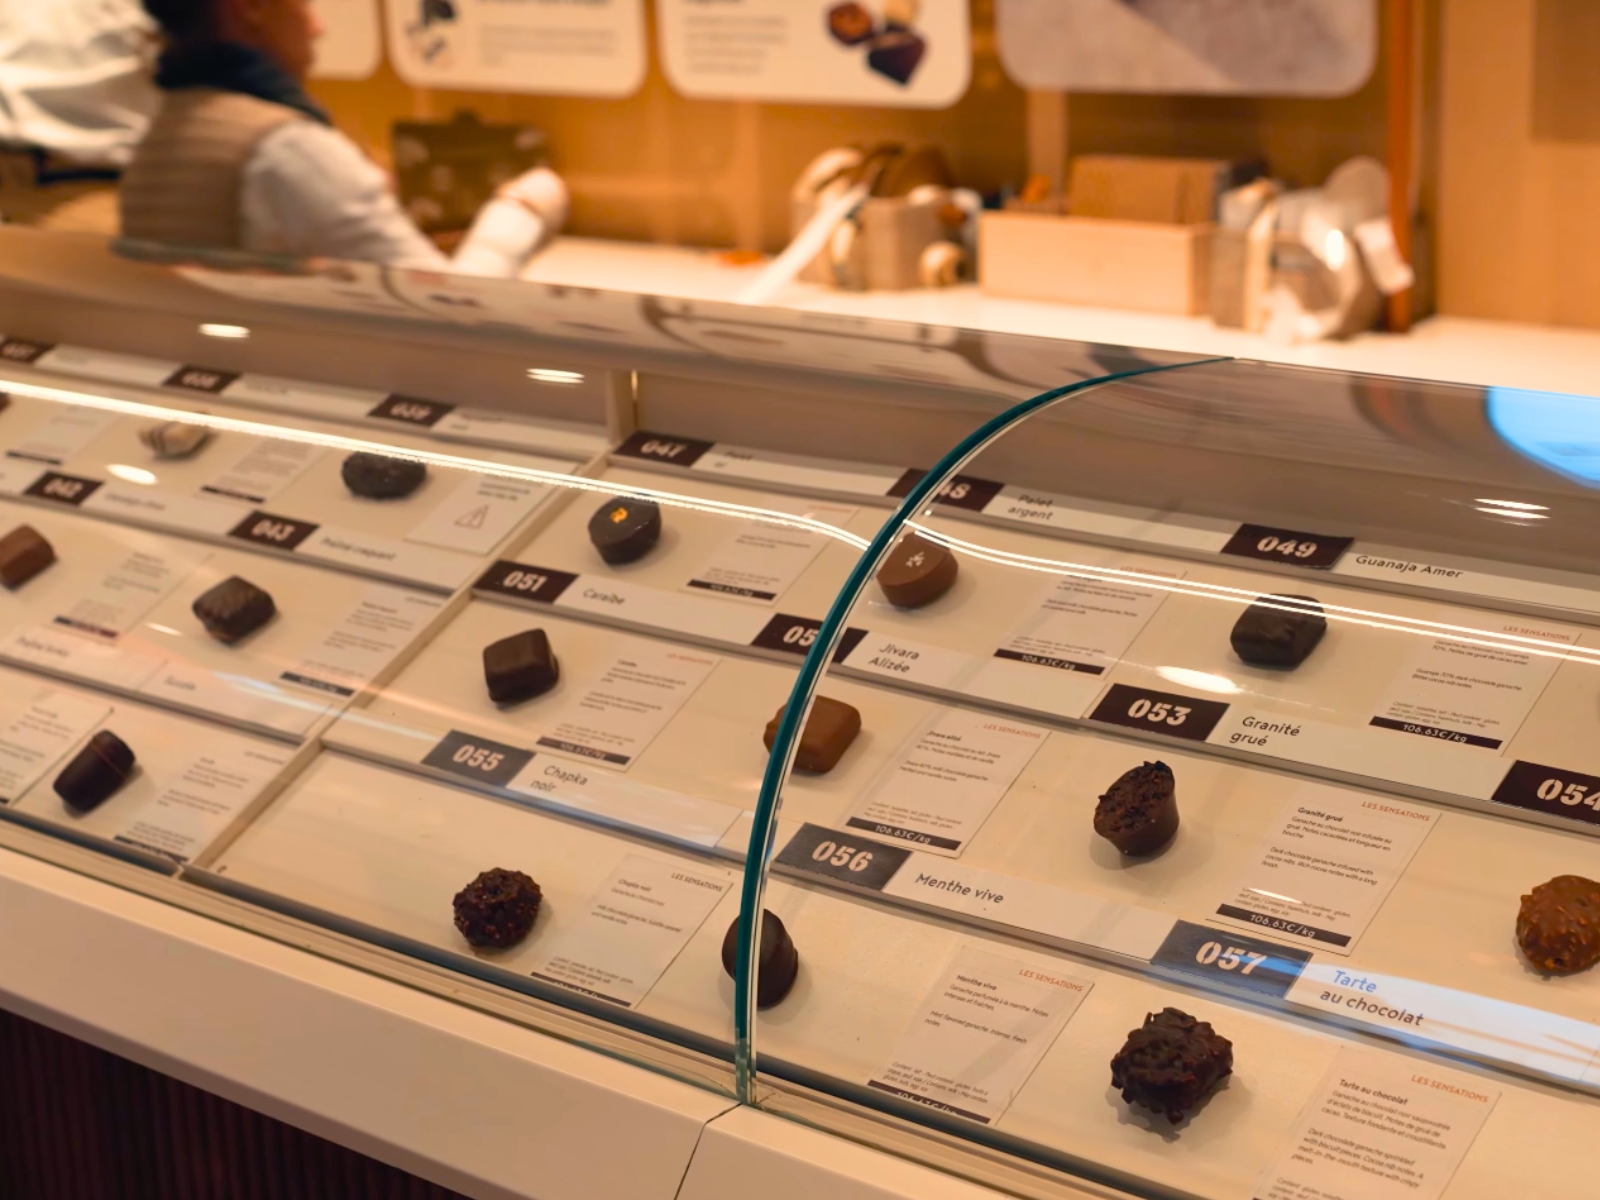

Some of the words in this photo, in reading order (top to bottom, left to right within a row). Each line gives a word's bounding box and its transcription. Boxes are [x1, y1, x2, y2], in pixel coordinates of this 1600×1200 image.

[640, 439, 688, 458] 047
[1018, 493, 1054, 508] Palet
[1007, 505, 1054, 520] argent
[1256, 536, 1318, 558] 049
[1355, 555, 1418, 573] Guanaja
[1420, 565, 1464, 579] Amer
[503, 571, 548, 593] 051
[1520, 628, 1570, 640] SENSATIONS
[879, 643, 920, 660] Jivara
[867, 656, 911, 673] Alizée
[1127, 698, 1192, 726] 053
[998, 726, 1040, 738] SENSATIONS
[1241, 715, 1302, 737] Granité
[1229, 731, 1268, 747] grué
[452, 744, 505, 771] 055
[543, 765, 588, 785] Chapka
[530, 780, 557, 792] noir
[1536, 778, 1600, 812] 054
[1298, 807, 1325, 818] Granité
[1361, 801, 1377, 809] LES
[1379, 805, 1430, 821] SENSATIONS
[811, 841, 873, 872] 056
[684, 876, 722, 891] SENSATIONS
[914, 873, 971, 896] Menthe
[974, 888, 1004, 904] vive
[1195, 941, 1268, 975] 057
[957, 975, 982, 986] Menthe
[1019, 969, 1034, 977] LES
[1035, 973, 1083, 991] SENSATIONS
[1333, 970, 1377, 993] Tarte
[1320, 988, 1351, 1004] au
[1346, 996, 1425, 1027] chocolat
[1340, 1079, 1360, 1090] Tarte
[1372, 1091, 1408, 1104] chocolat
[1411, 1075, 1429, 1085] LES
[1430, 1081, 1488, 1102] SENSATIONS
[1343, 1112, 1366, 1124] Texture
[1385, 1116, 1406, 1126] Notes
[1303, 1137, 1318, 1145] with
[1308, 1128, 1323, 1137] Dark
[1323, 1134, 1355, 1147] chocolate
[1384, 1173, 1401, 1181] with
